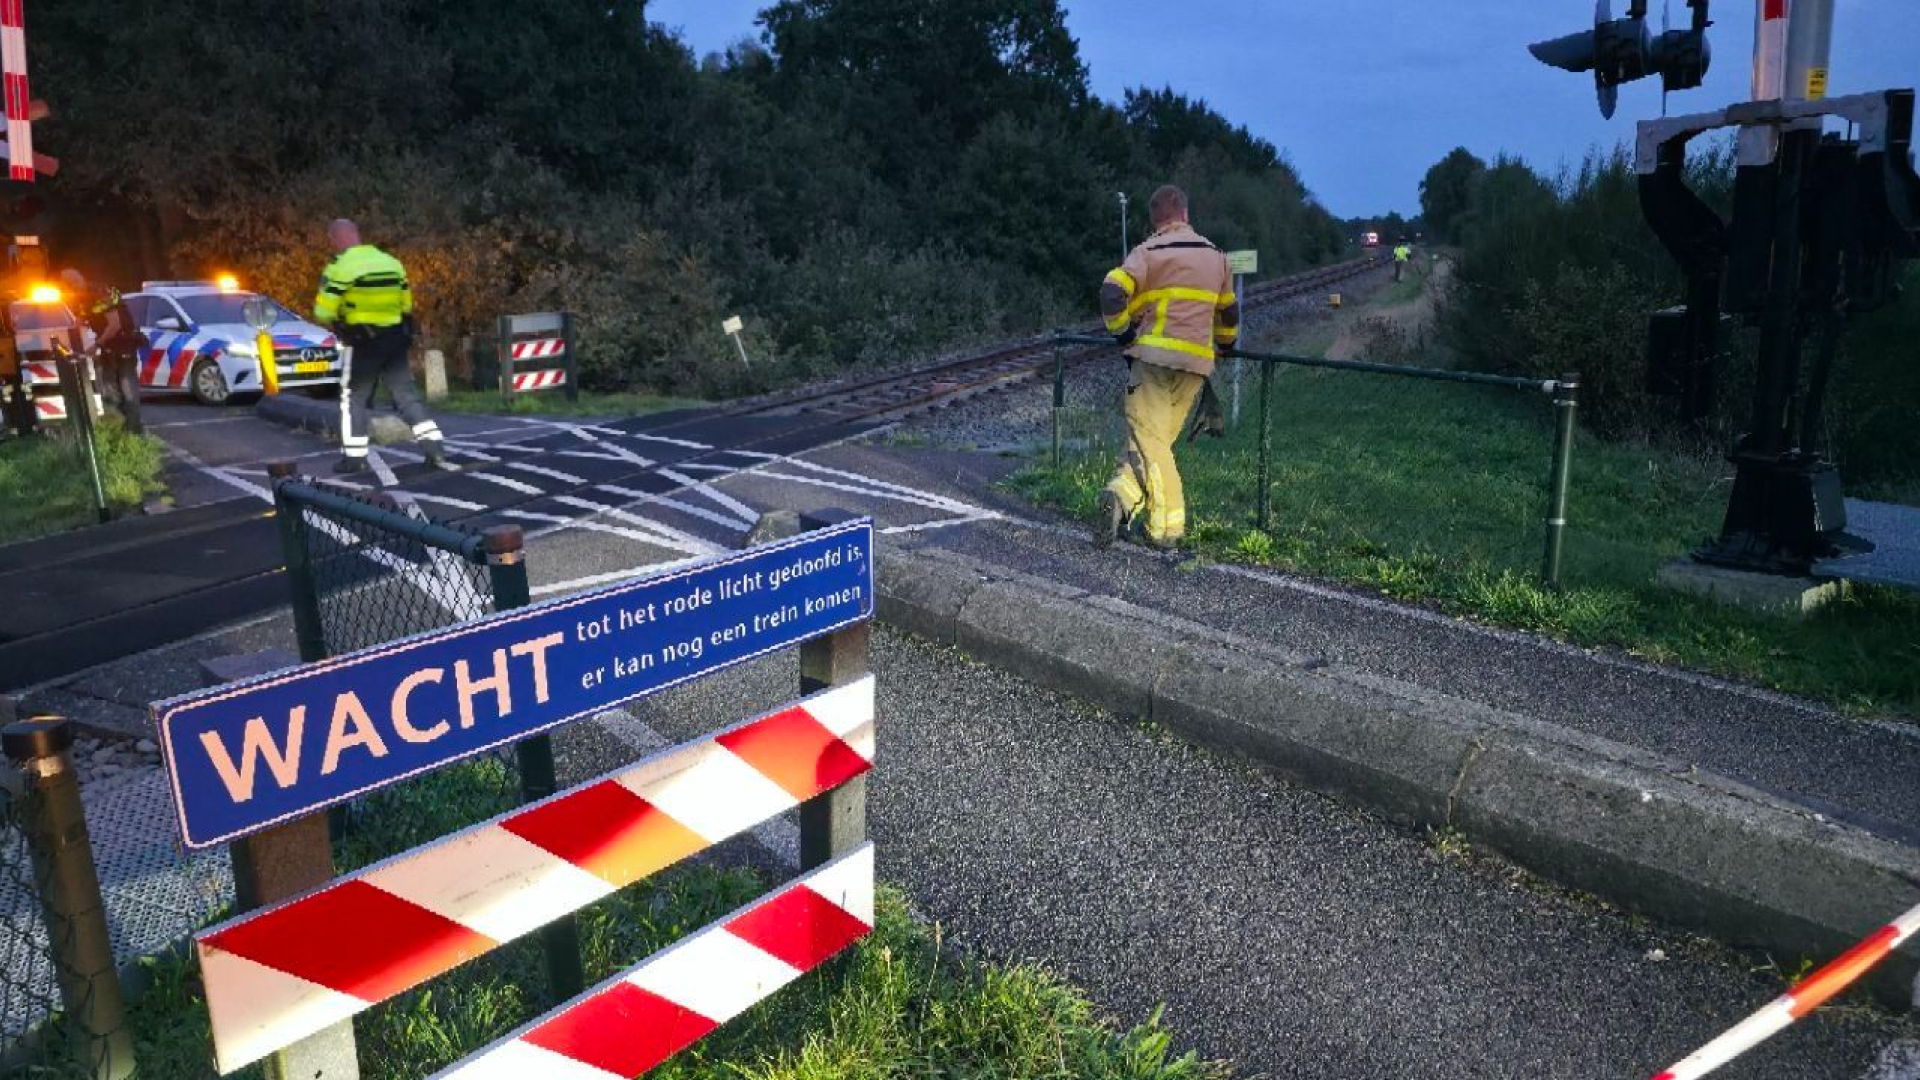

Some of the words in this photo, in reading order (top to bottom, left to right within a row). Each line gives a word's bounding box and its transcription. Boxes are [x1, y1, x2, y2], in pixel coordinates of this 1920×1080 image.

[577, 613, 612, 641] tot
[620, 603, 656, 629] het
[664, 586, 713, 616] rode
[720, 571, 763, 600] licht
[769, 546, 841, 590] gedoofd
[582, 666, 605, 689] er
[614, 654, 655, 678] kan
[662, 636, 703, 662] nog
[711, 622, 746, 646] een
[753, 604, 798, 633] trein
[804, 585, 861, 616] komen
[199, 632, 565, 803] WACHT
